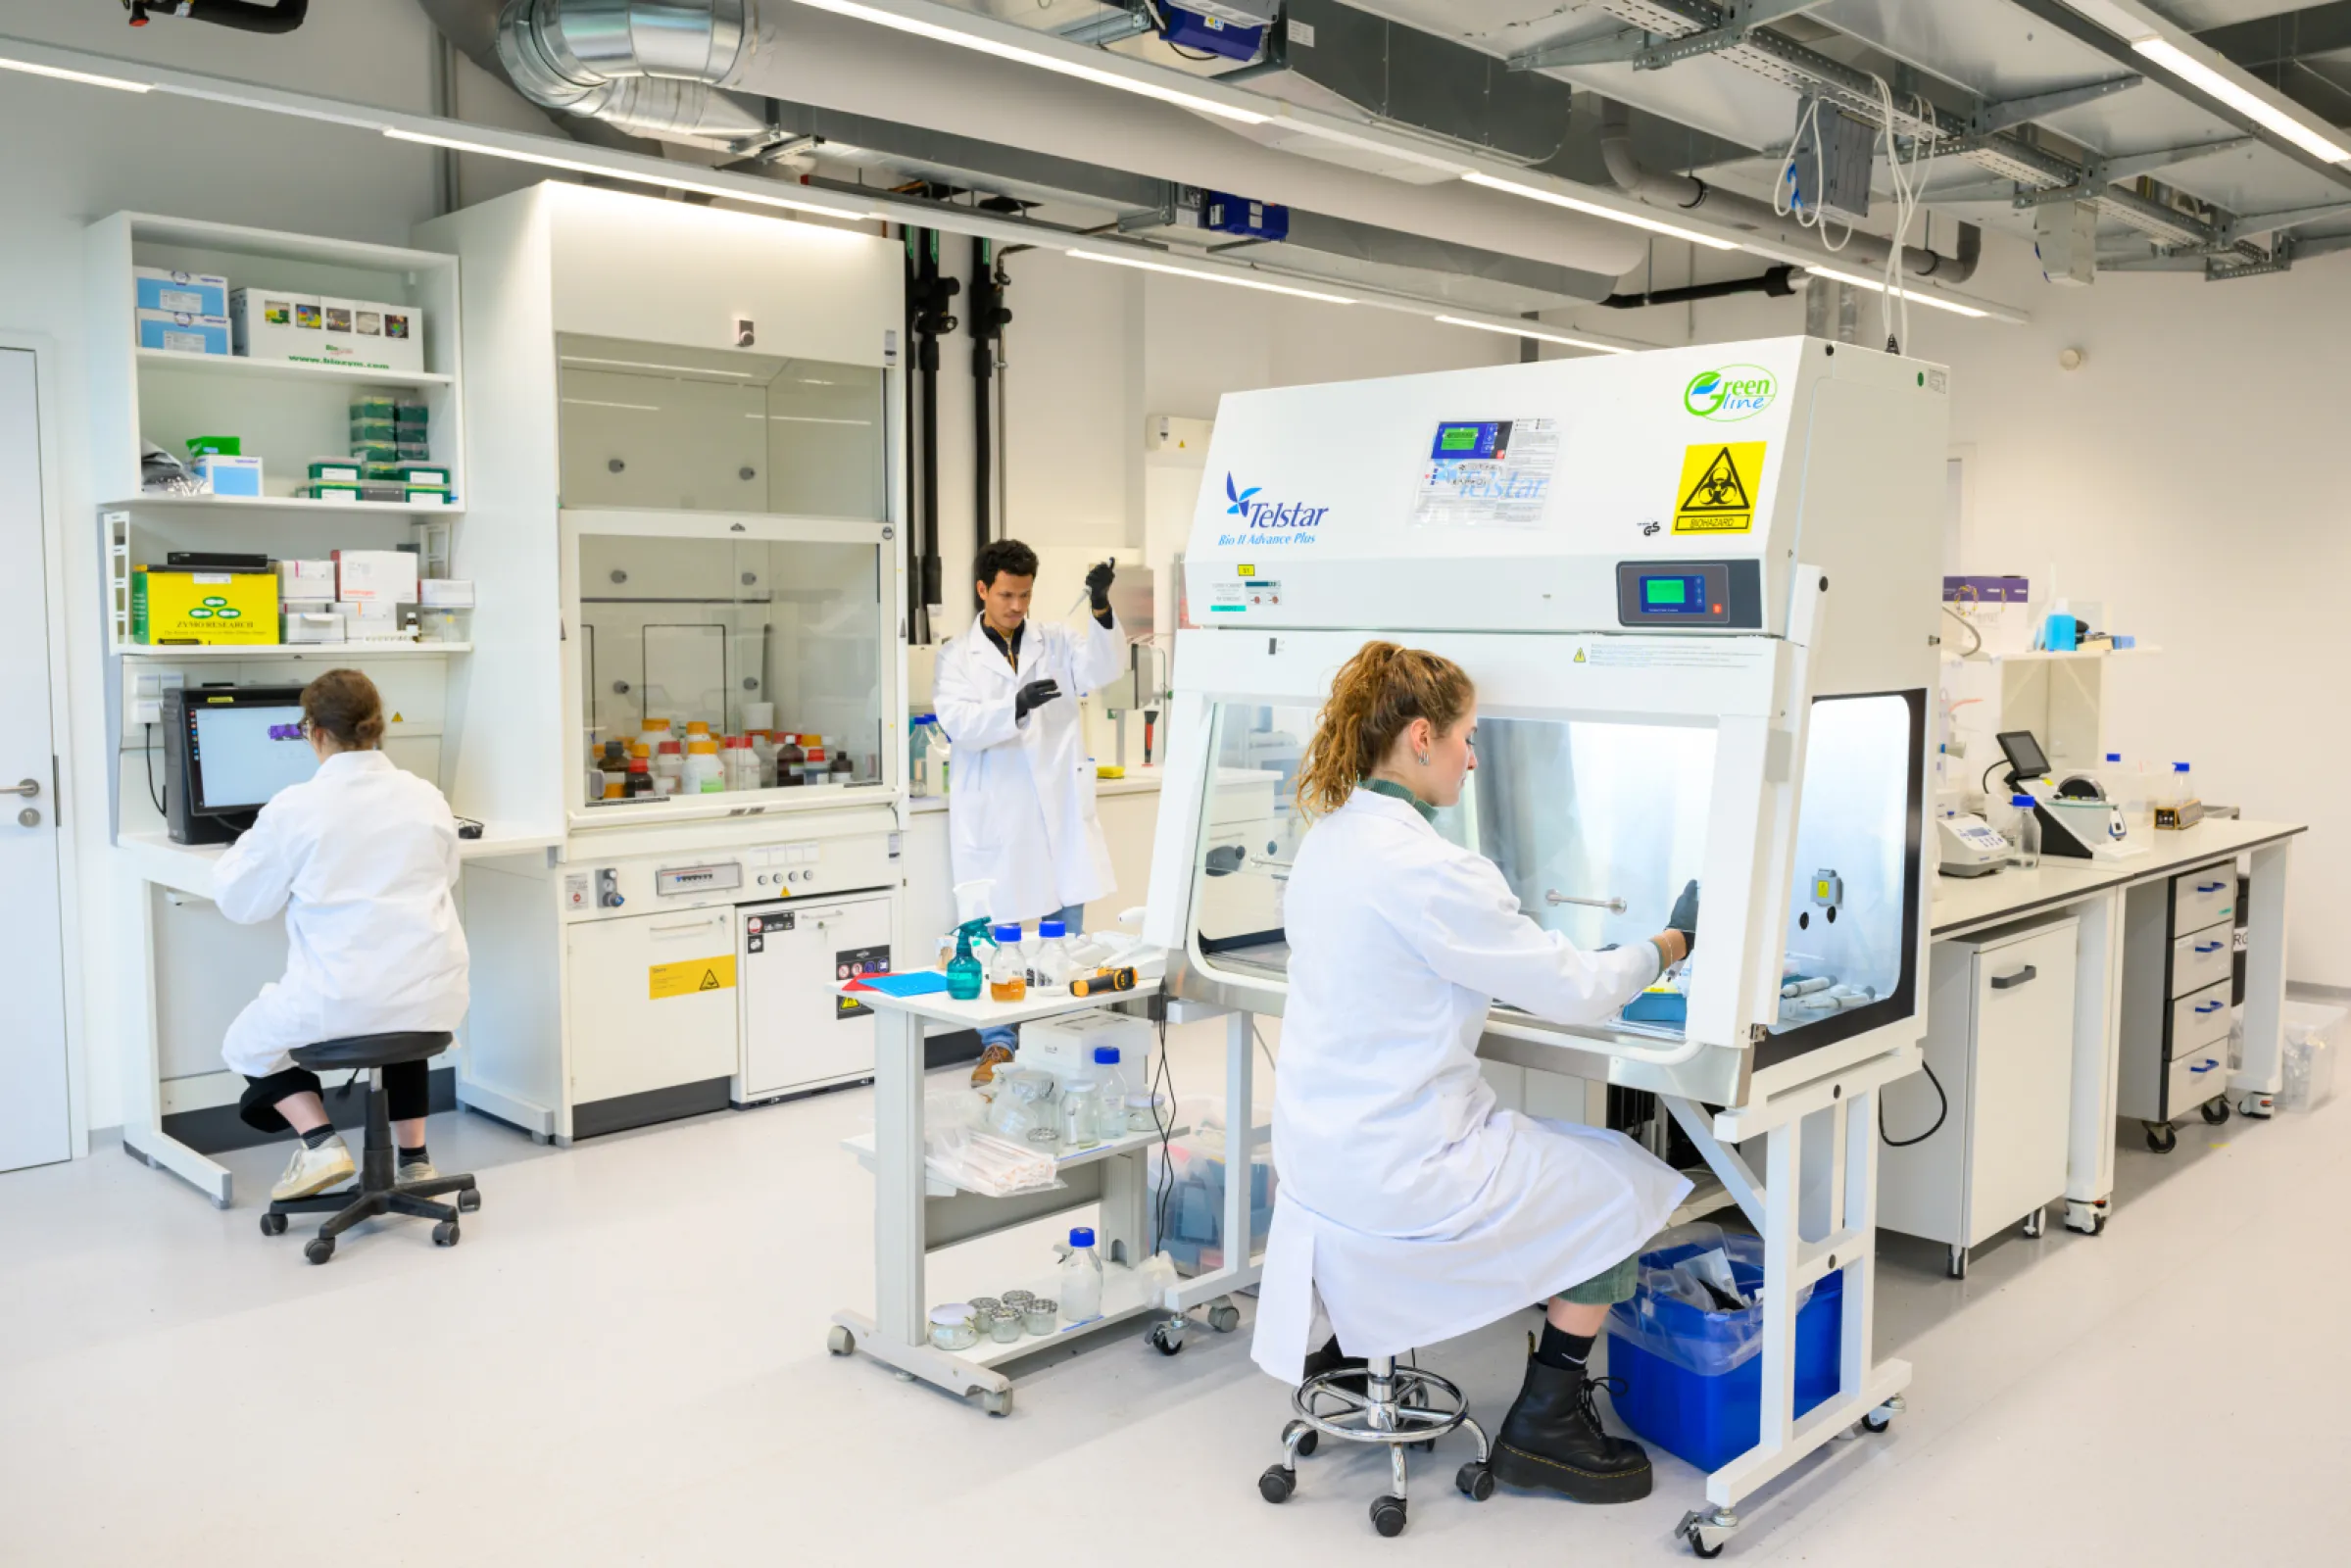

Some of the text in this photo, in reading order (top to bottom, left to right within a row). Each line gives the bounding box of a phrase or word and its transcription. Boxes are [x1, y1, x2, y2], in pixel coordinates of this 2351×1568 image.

[1684, 371, 1770, 416] Green
[1722, 393, 1765, 410] line
[1249, 501, 1330, 528] Telstar
[1690, 516, 1735, 527] BIOHAZARD
[1218, 534, 1235, 546] Bio
[1249, 533, 1292, 545] Advance
[1294, 531, 1316, 544] Plus
